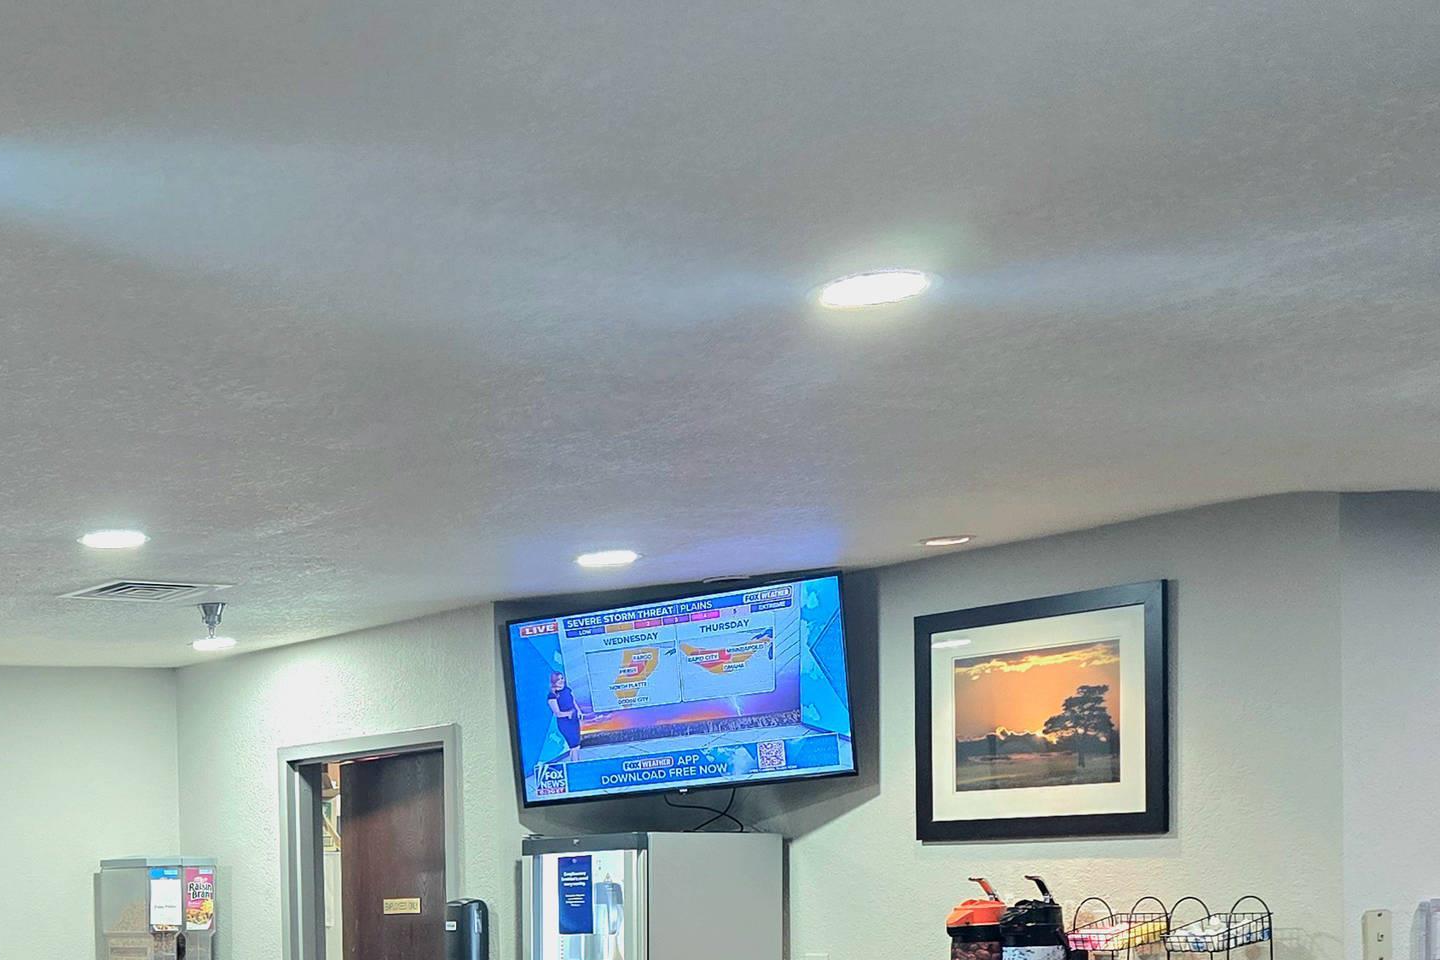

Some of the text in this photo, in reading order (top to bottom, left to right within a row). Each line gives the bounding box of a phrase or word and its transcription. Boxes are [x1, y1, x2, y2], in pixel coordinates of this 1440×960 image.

[745, 592, 760, 602] FOX
[567, 601, 712, 628] SEVERE STORM THREAT PLAINS
[525, 624, 554, 635] LIVE
[700, 620, 750, 633] THURSDAY
[603, 632, 659, 646] WEDNESDAY
[625, 754, 700, 770] FOX WEATHER APP
[545, 770, 563, 780] FOX
[601, 763, 727, 785] DOWNLOAD FREE NOW
[541, 780, 565, 789] NEWS
[192, 890, 209, 899] Bran
